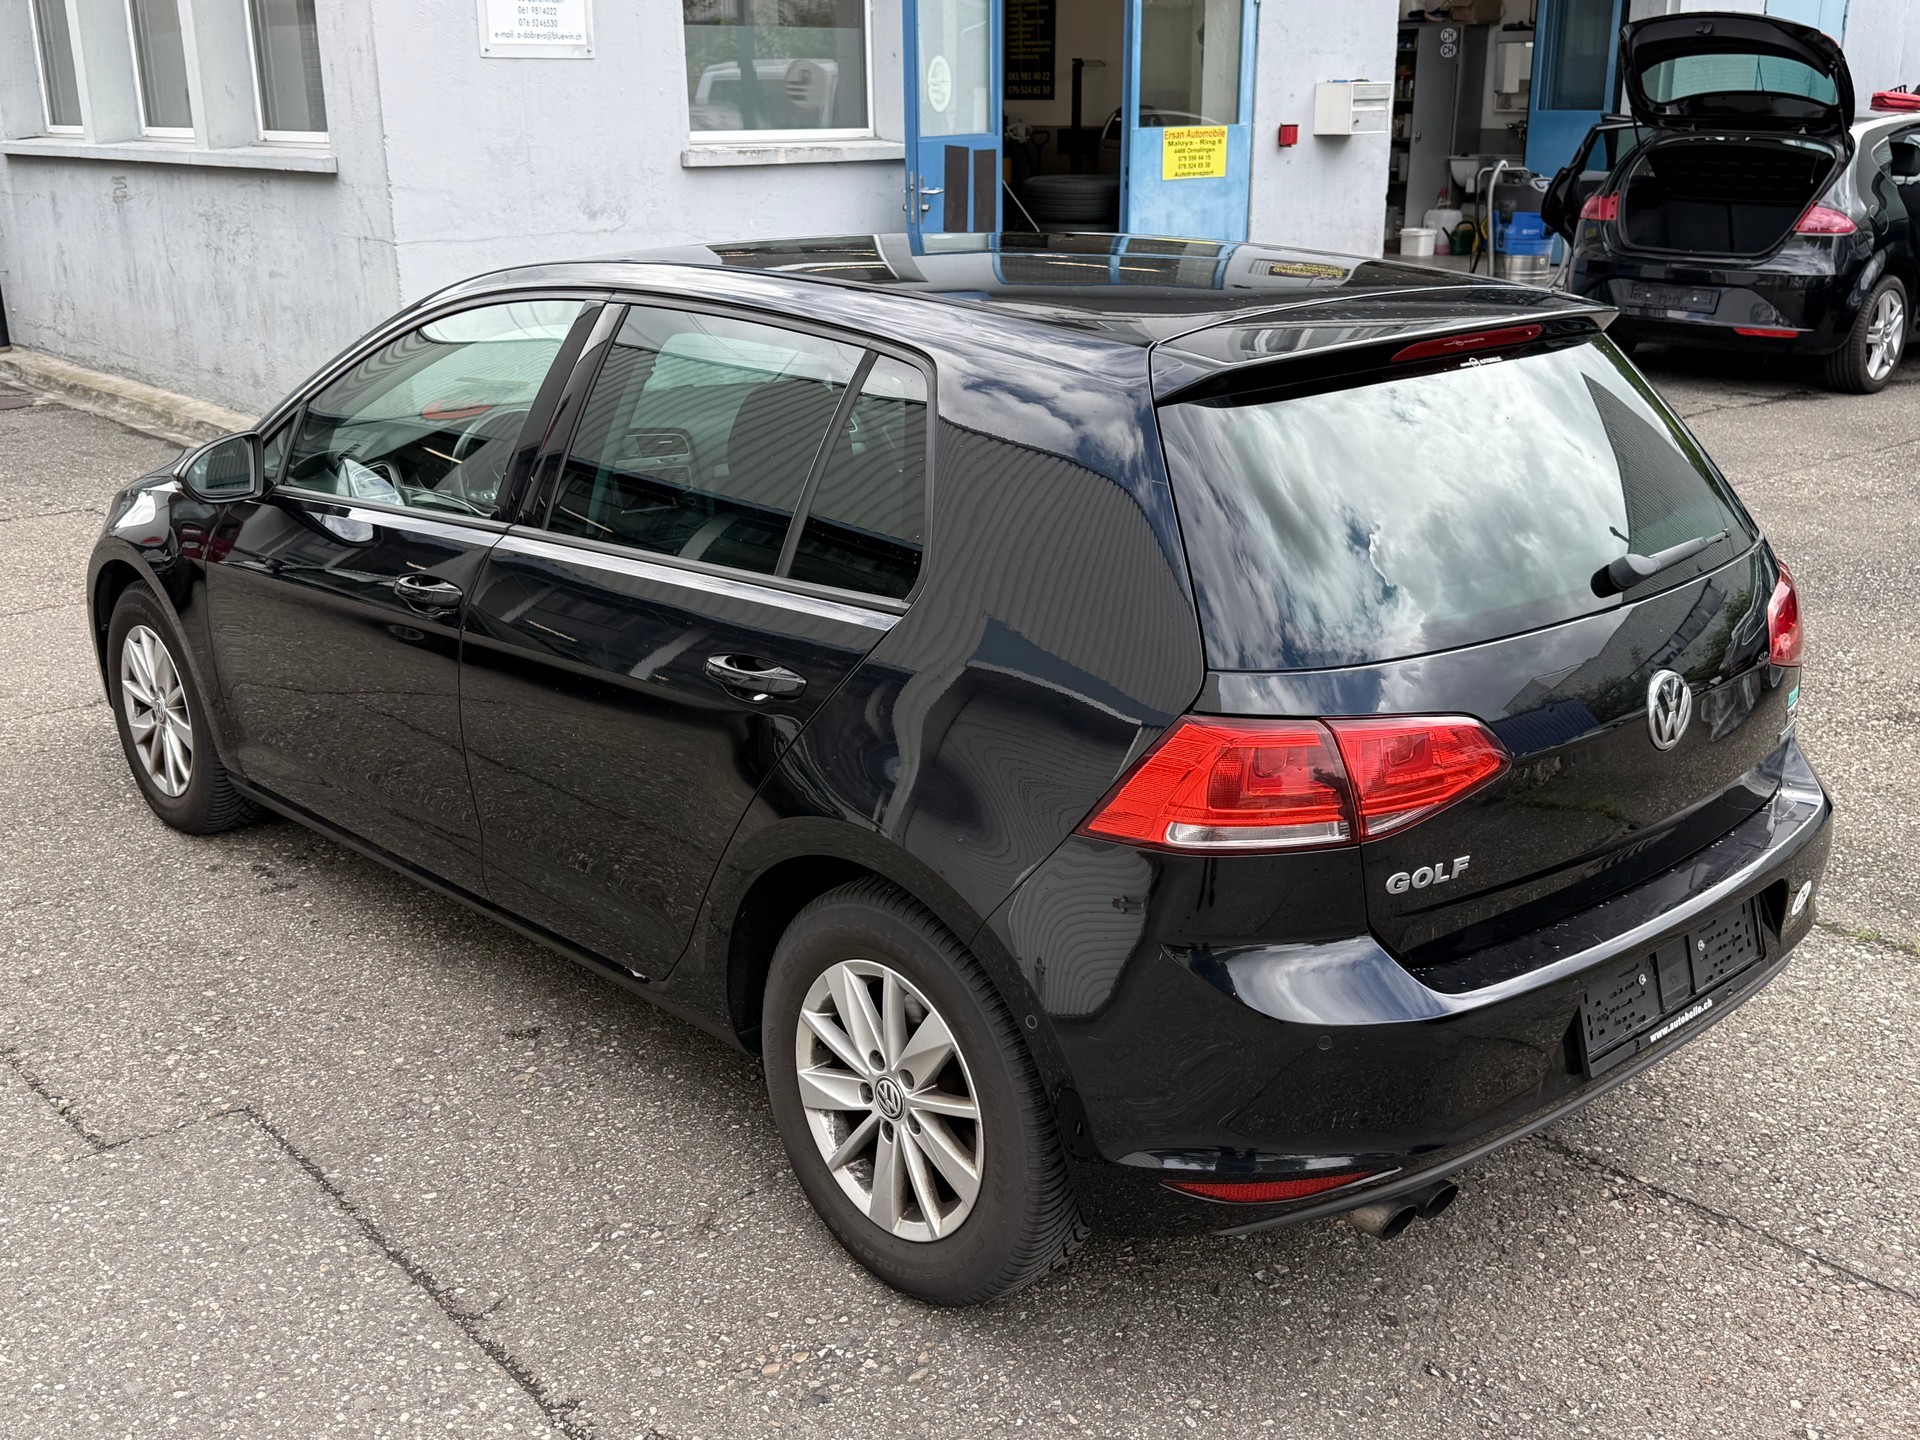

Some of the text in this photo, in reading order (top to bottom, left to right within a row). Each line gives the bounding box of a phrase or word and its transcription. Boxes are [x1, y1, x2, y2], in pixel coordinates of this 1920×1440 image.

[518, 6, 557, 15] 061 9814022
[518, 18, 530, 26] 076
[1164, 129, 1226, 140] Ersan Automobile
[1385, 855, 1470, 894] GOLF
